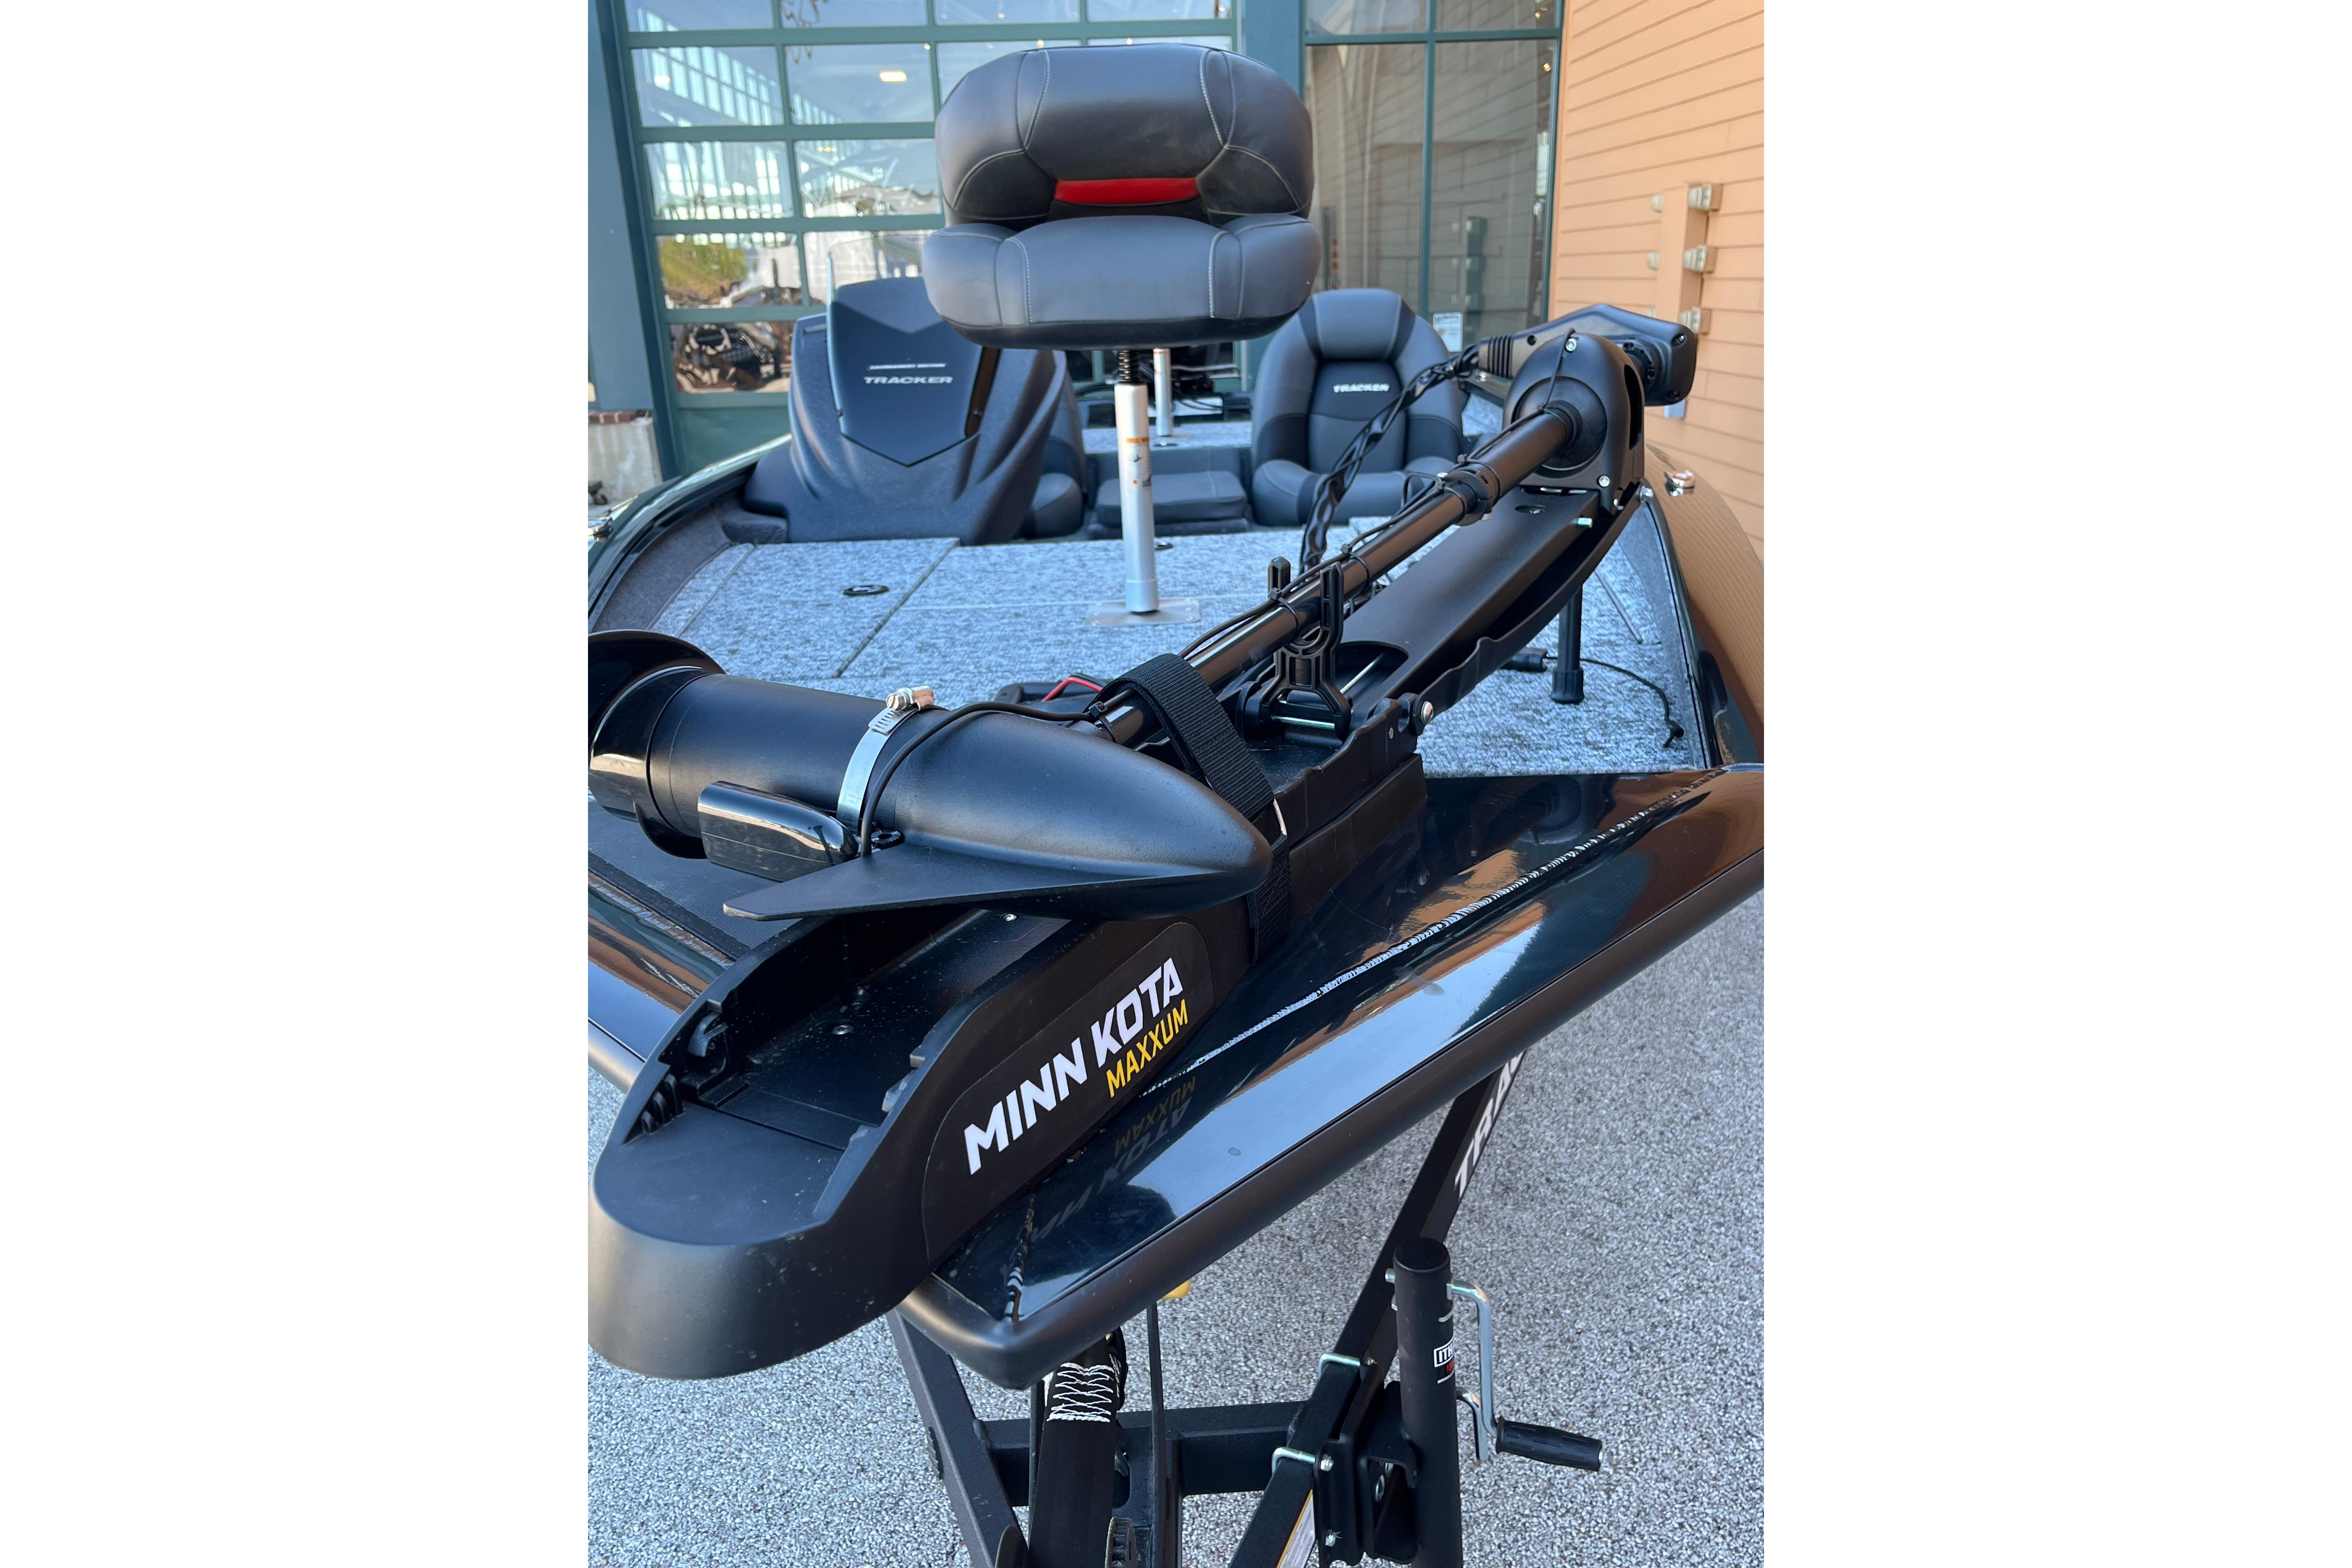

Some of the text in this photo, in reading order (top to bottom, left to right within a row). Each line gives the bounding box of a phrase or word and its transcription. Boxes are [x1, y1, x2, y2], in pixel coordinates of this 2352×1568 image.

[964, 957, 1183, 1175] MINN KOTA
[1106, 999, 1188, 1098] MAXXUM
